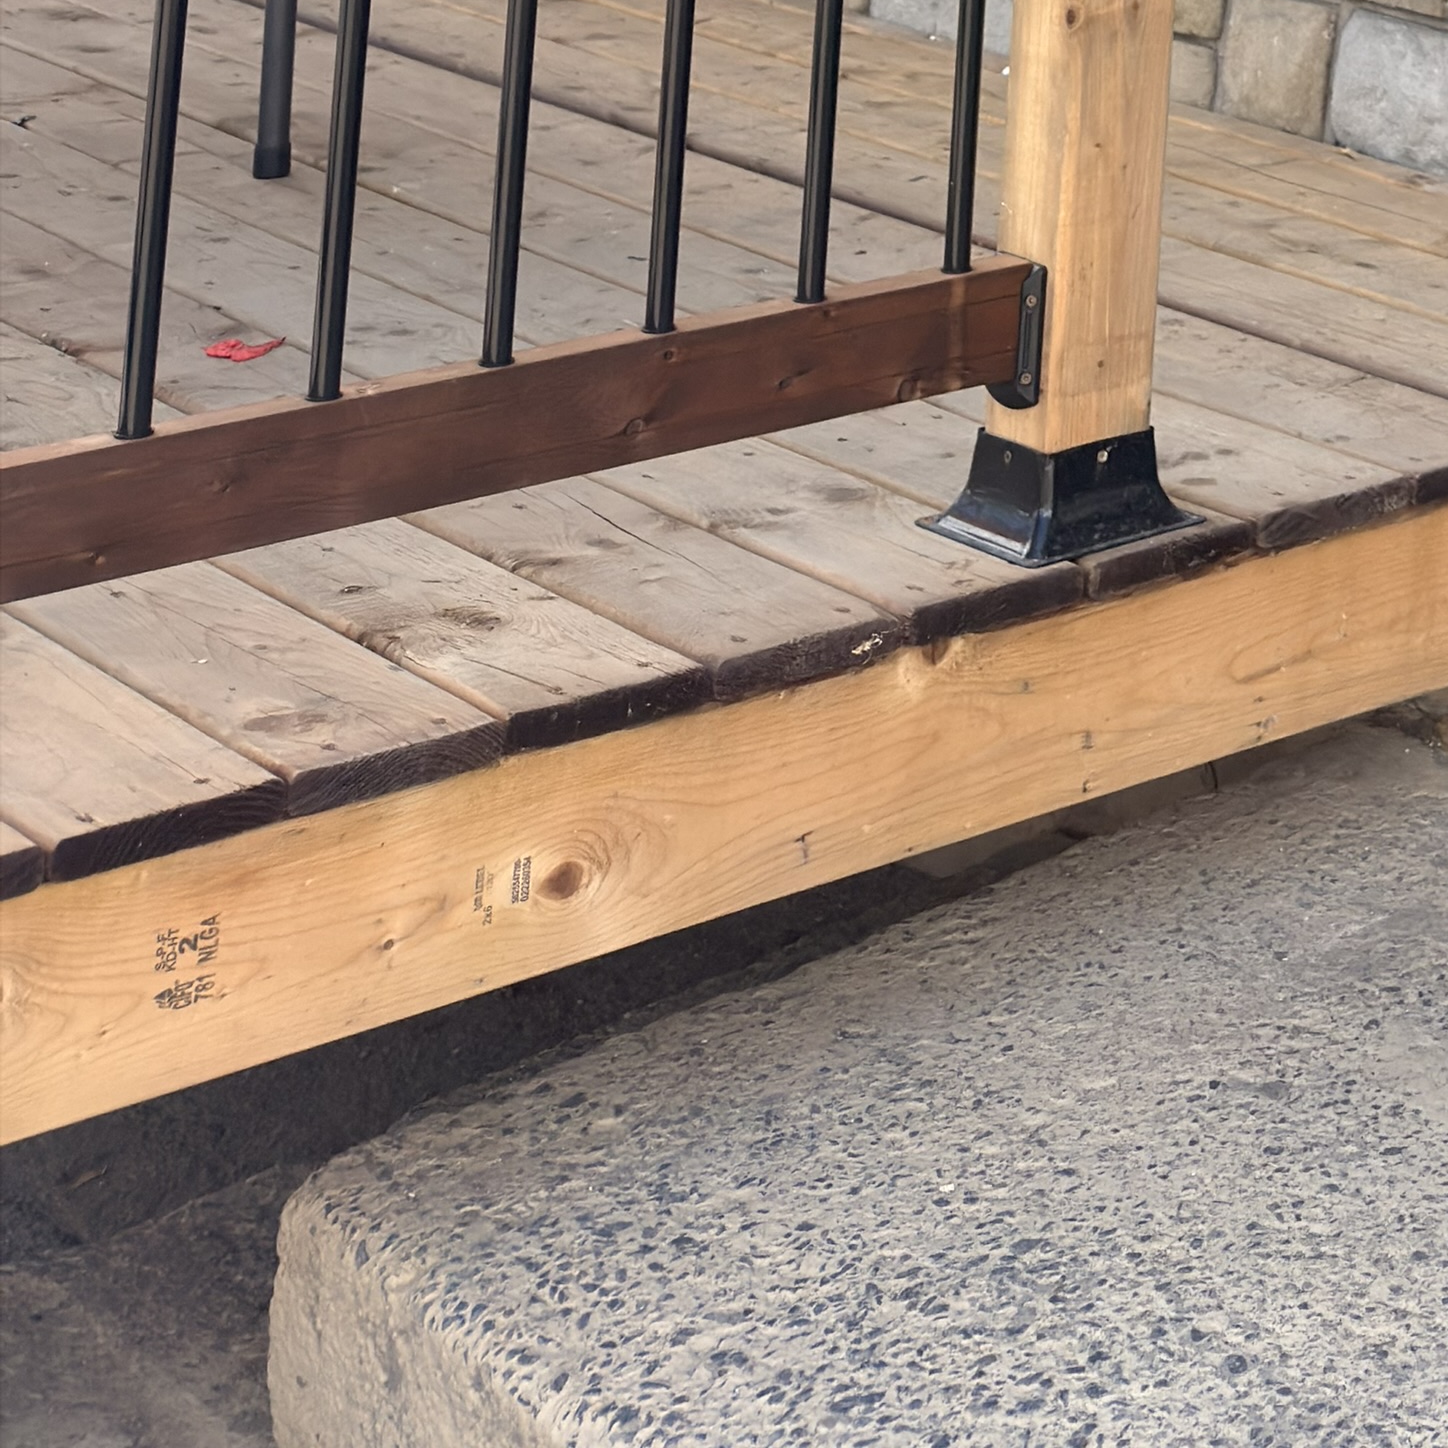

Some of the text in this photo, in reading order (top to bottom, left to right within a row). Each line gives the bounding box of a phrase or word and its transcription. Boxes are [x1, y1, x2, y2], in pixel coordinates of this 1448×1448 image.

[178, 933, 199, 954] 2
[194, 911, 222, 1004] 781 NLGA
